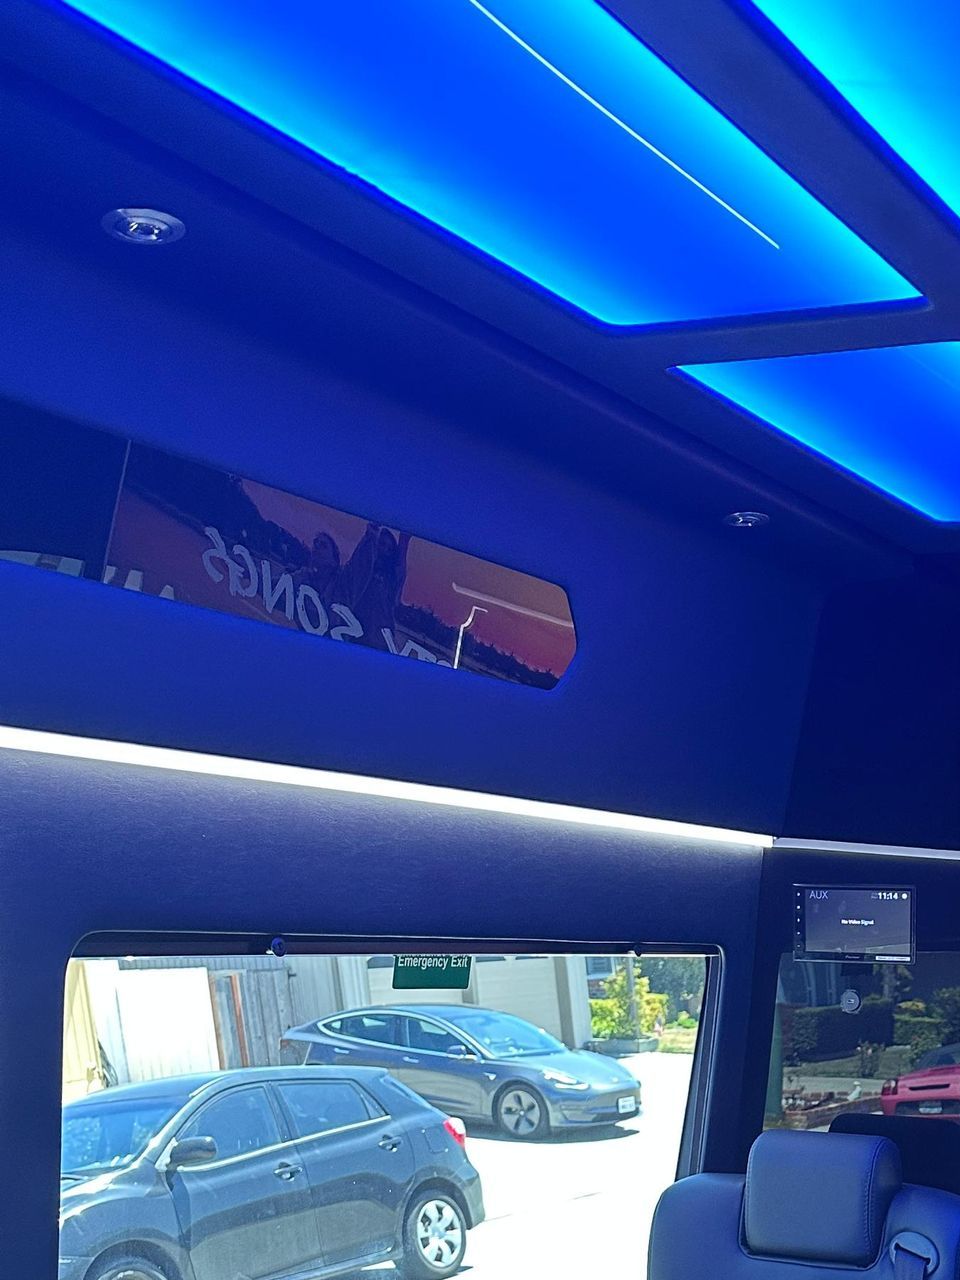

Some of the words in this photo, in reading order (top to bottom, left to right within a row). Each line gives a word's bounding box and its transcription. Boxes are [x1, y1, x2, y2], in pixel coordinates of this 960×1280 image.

[809, 890, 828, 899] AUX
[398, 956, 448, 970] Emergency
[451, 956, 468, 968] Exit
